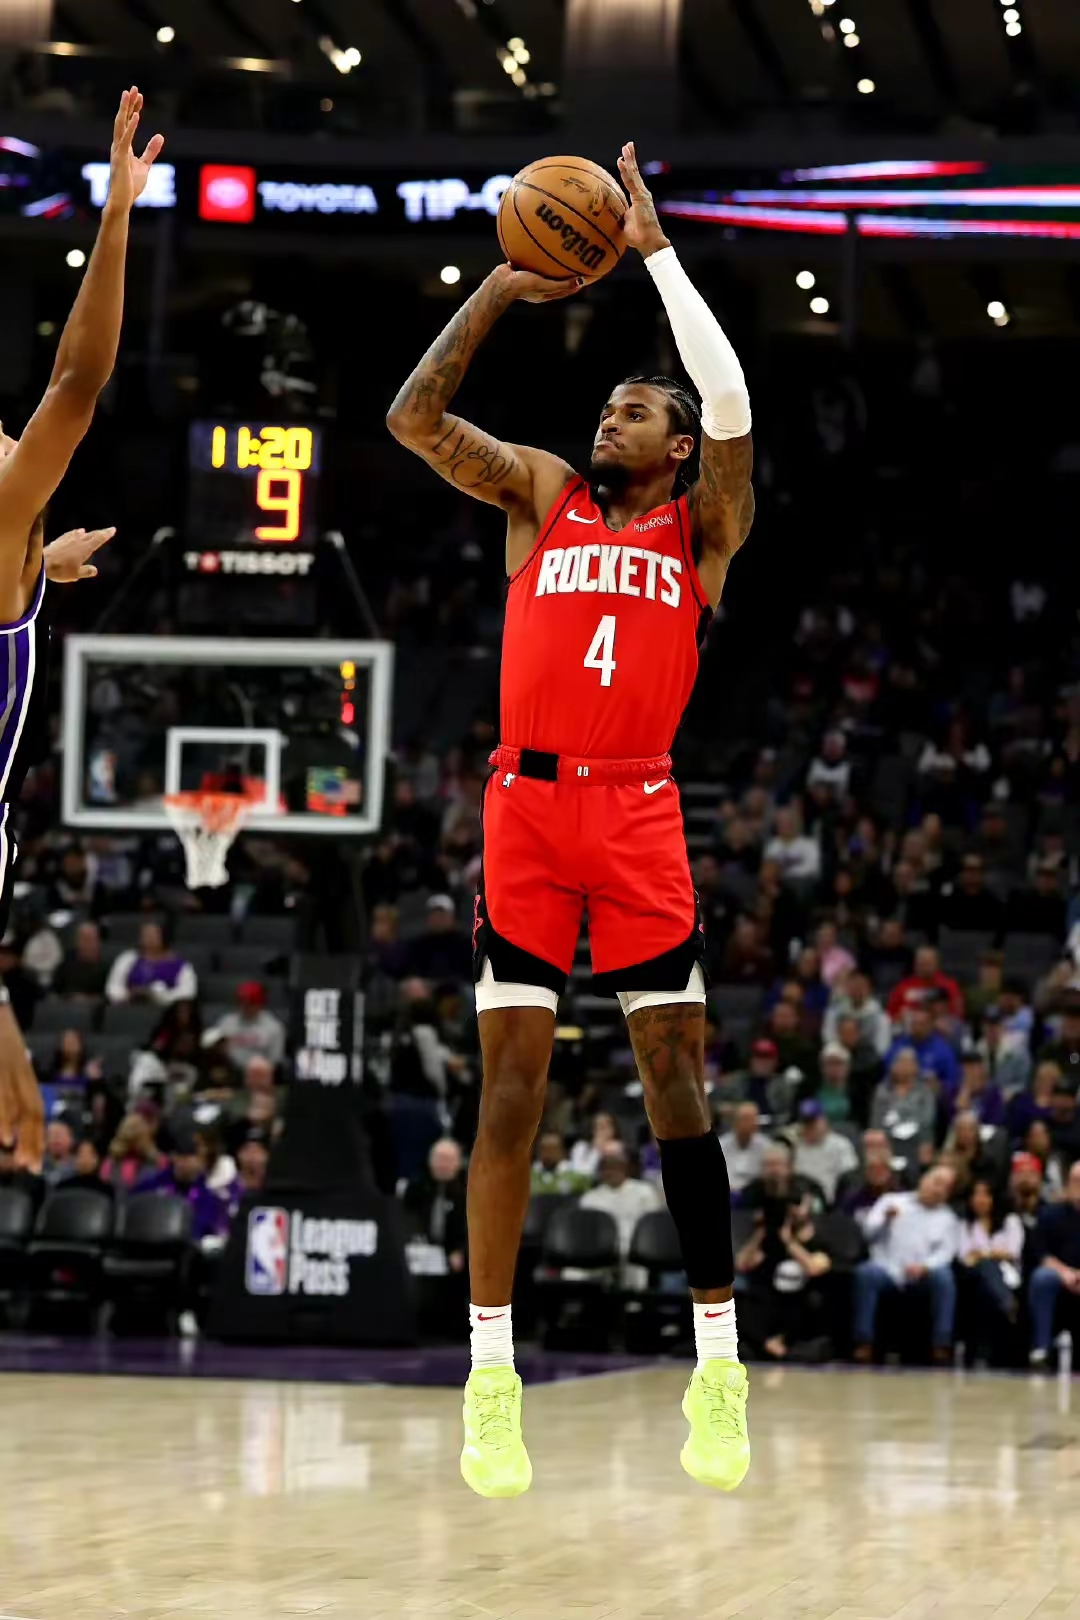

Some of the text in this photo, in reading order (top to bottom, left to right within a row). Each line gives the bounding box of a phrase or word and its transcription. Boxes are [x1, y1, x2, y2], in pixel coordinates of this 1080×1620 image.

[258, 180, 378, 213] TOYOTA
[535, 203, 606, 270] Wilson
[212, 426, 312, 469] 11:20
[255, 469, 301, 540] 9
[535, 543, 682, 608] ROCKETS
[583, 615, 616, 686] 4
[291, 1210, 377, 1258] League
[289, 1252, 350, 1295] Pass
